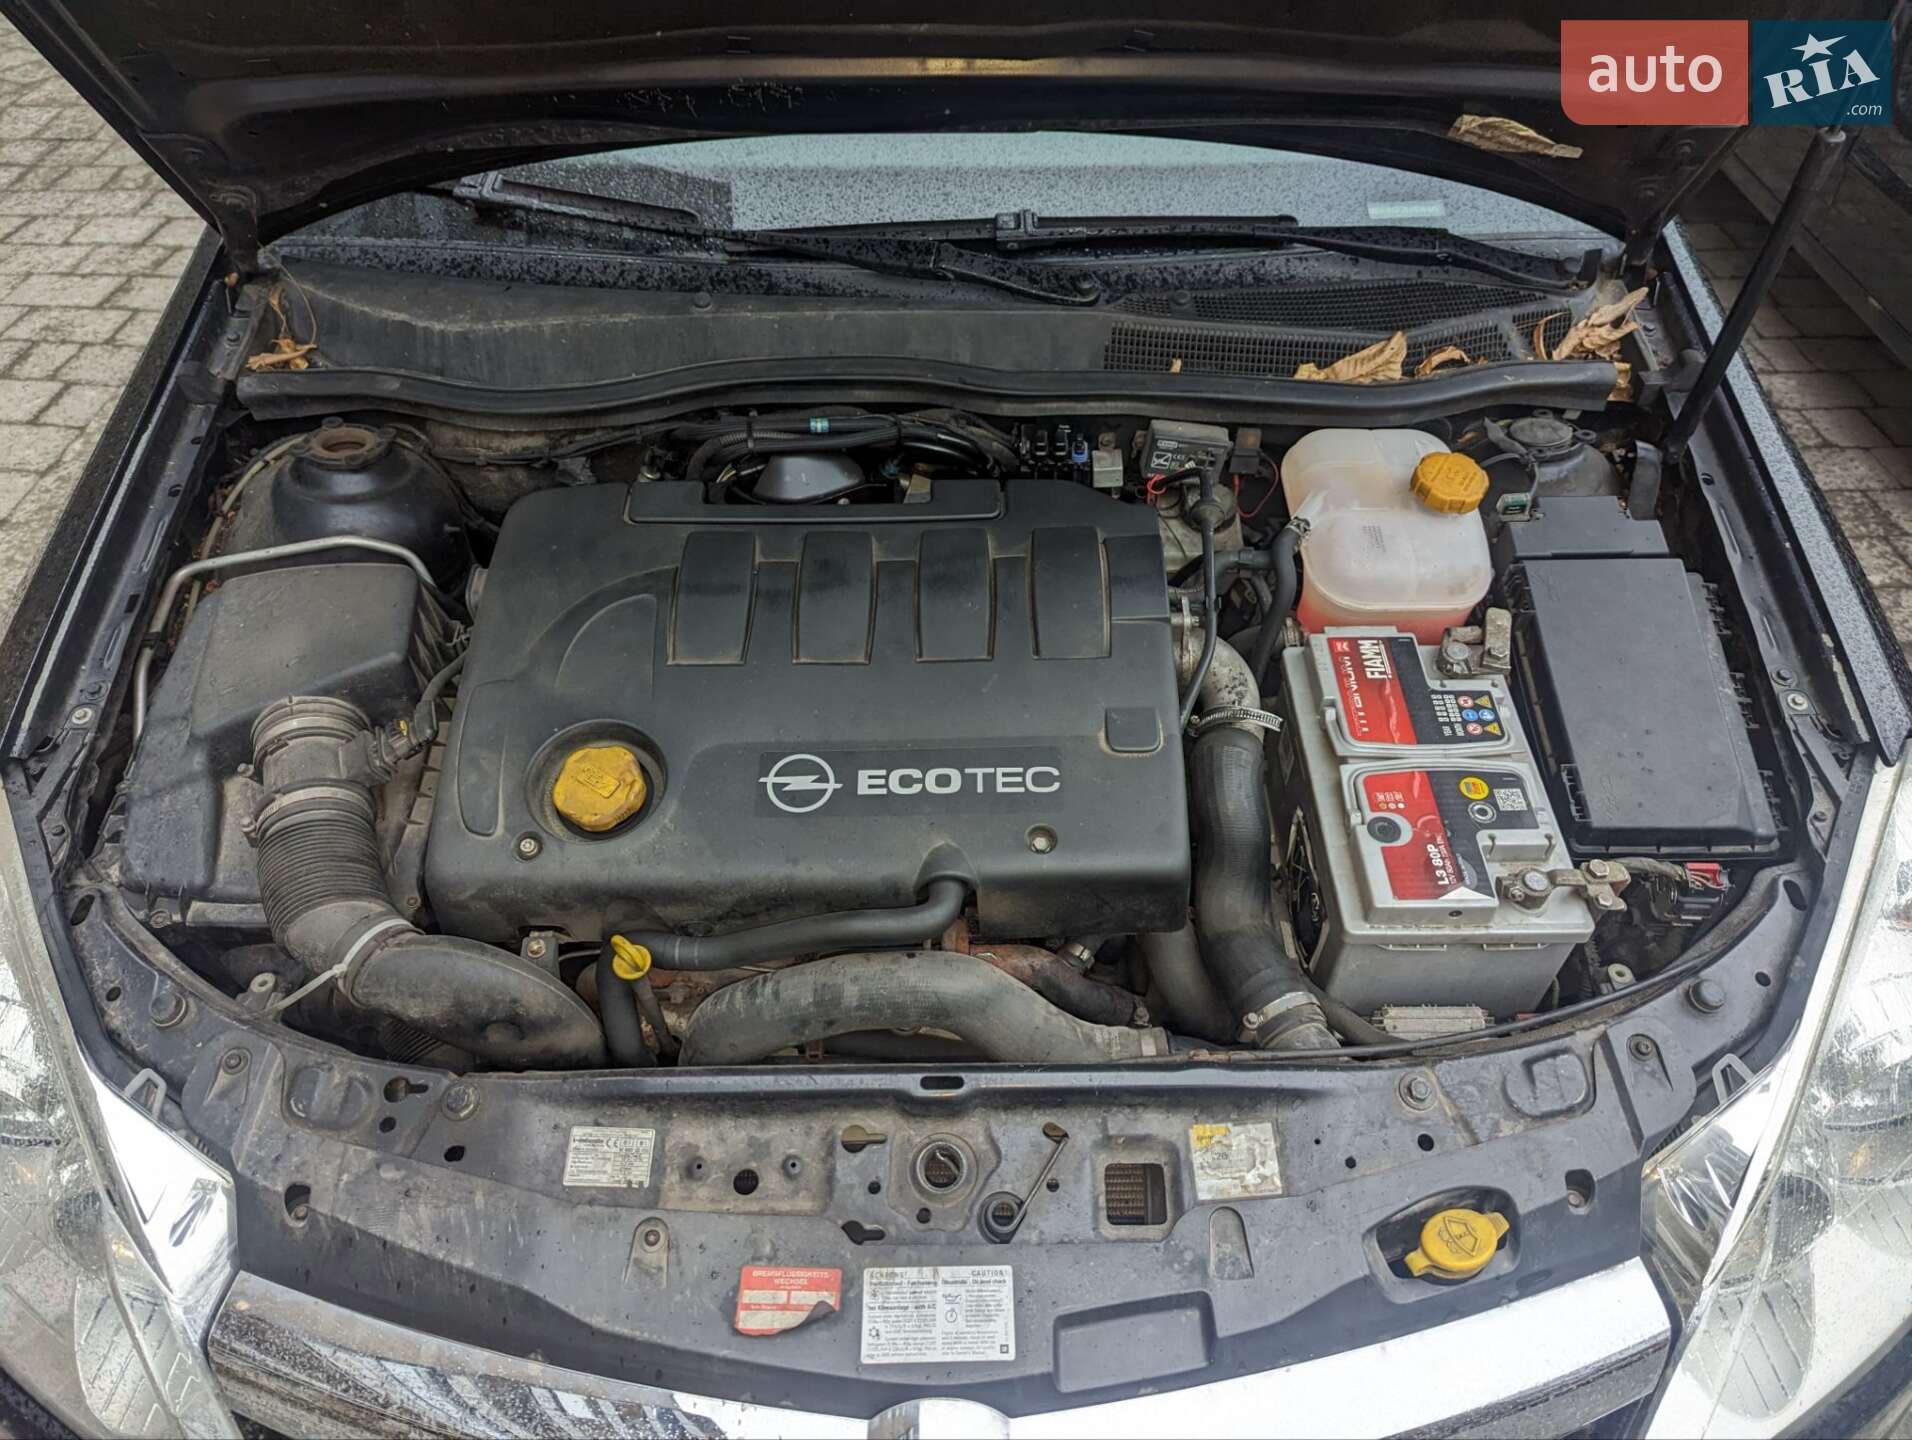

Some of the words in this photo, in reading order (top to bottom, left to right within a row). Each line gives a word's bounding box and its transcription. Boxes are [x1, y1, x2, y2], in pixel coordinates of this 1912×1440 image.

[1358, 639, 1388, 679] FIAMM
[857, 766, 1061, 795] ECOTEC
[1426, 843, 1443, 867] 80P
[1435, 869, 1450, 885] L3
